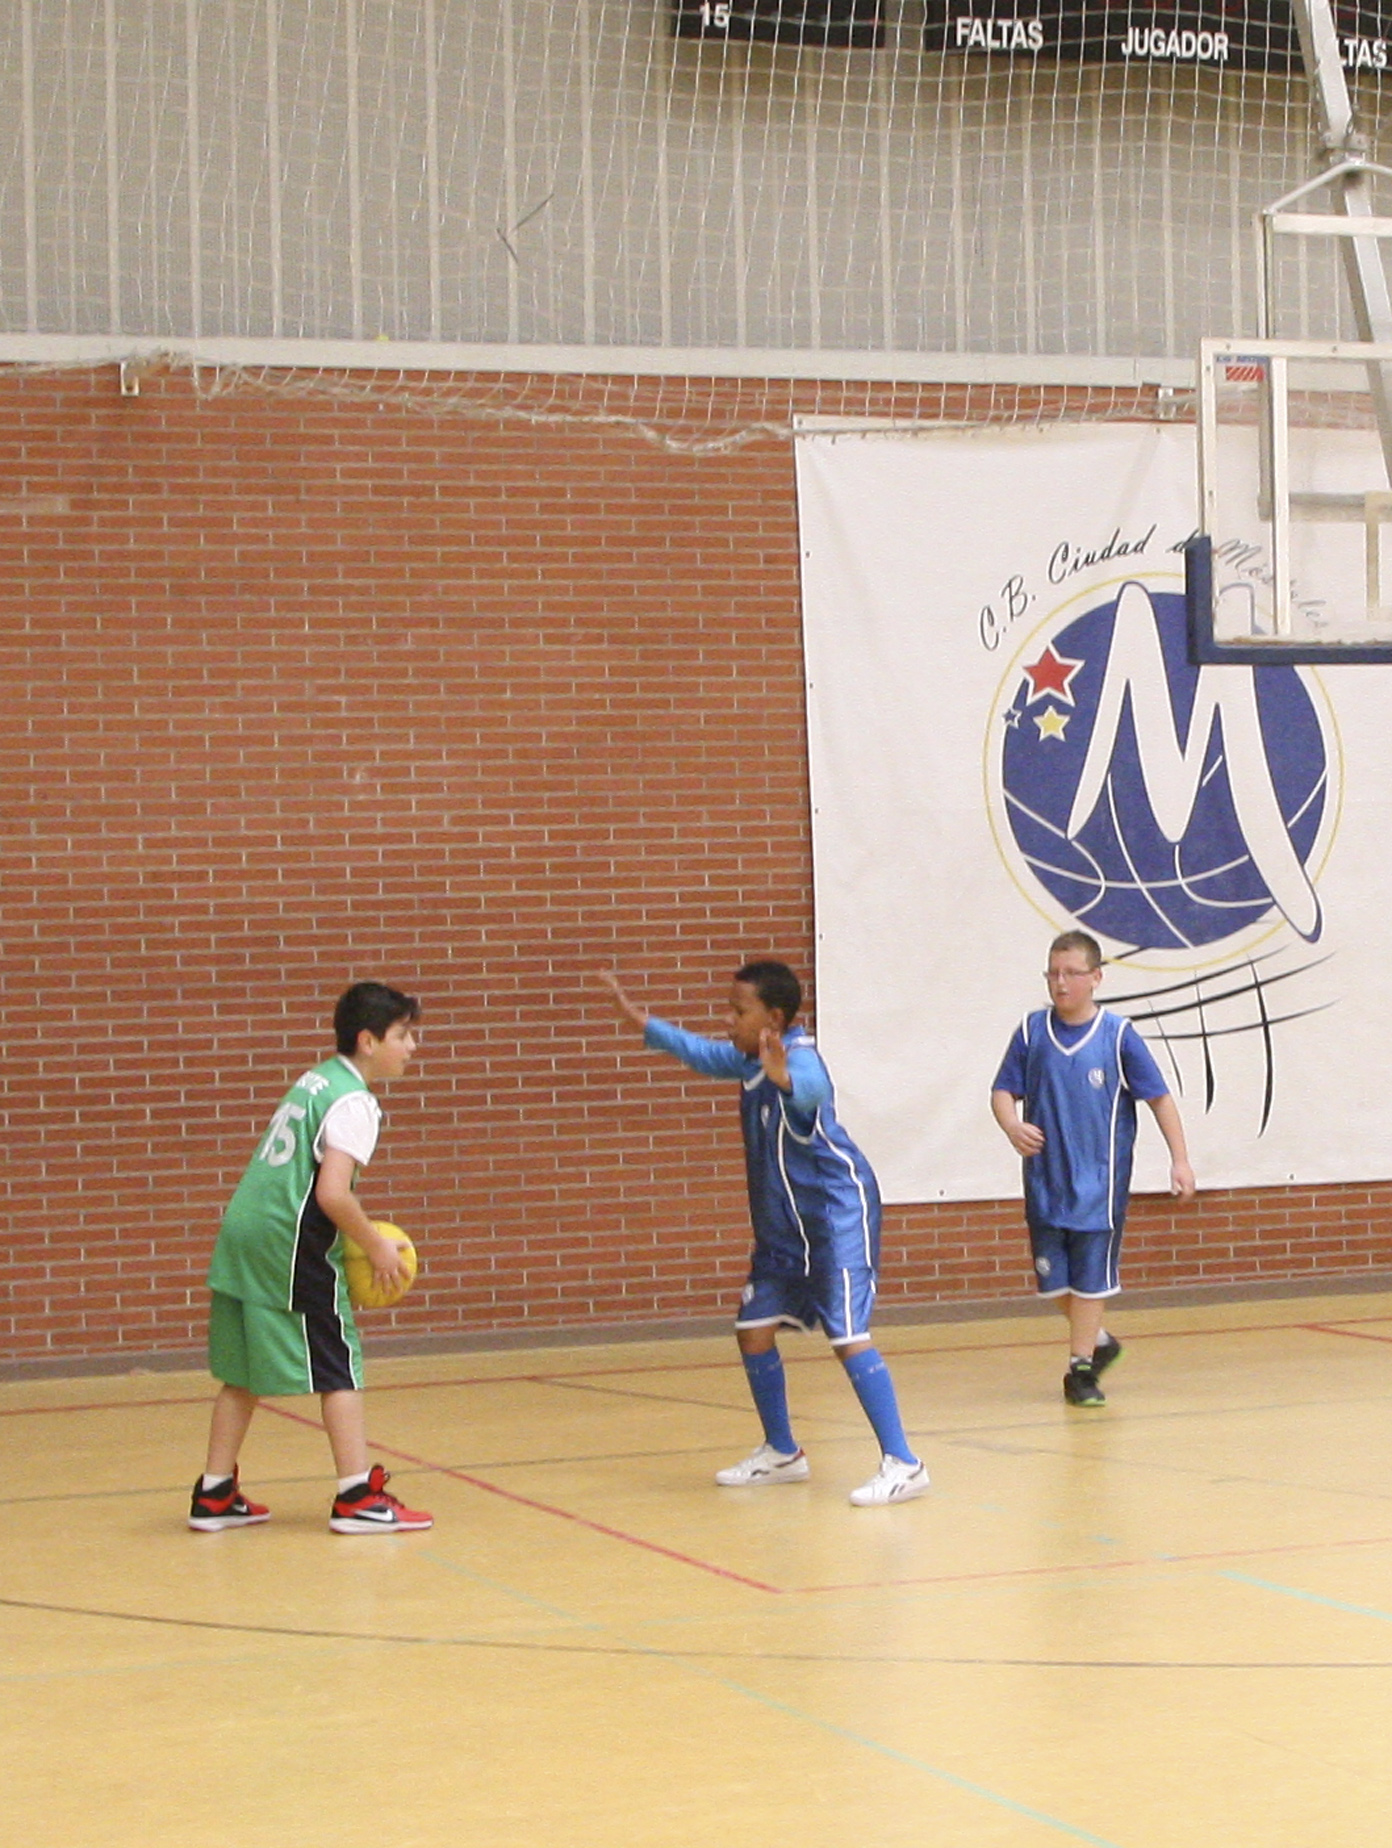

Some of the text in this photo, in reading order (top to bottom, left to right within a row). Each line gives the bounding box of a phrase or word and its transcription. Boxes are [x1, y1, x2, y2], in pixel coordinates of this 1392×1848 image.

[699, 2, 730, 28] 15
[955, 16, 1044, 50] FALTAS
[1121, 26, 1229, 61] JUGADOR
[1047, 523, 1158, 584] Ciudad
